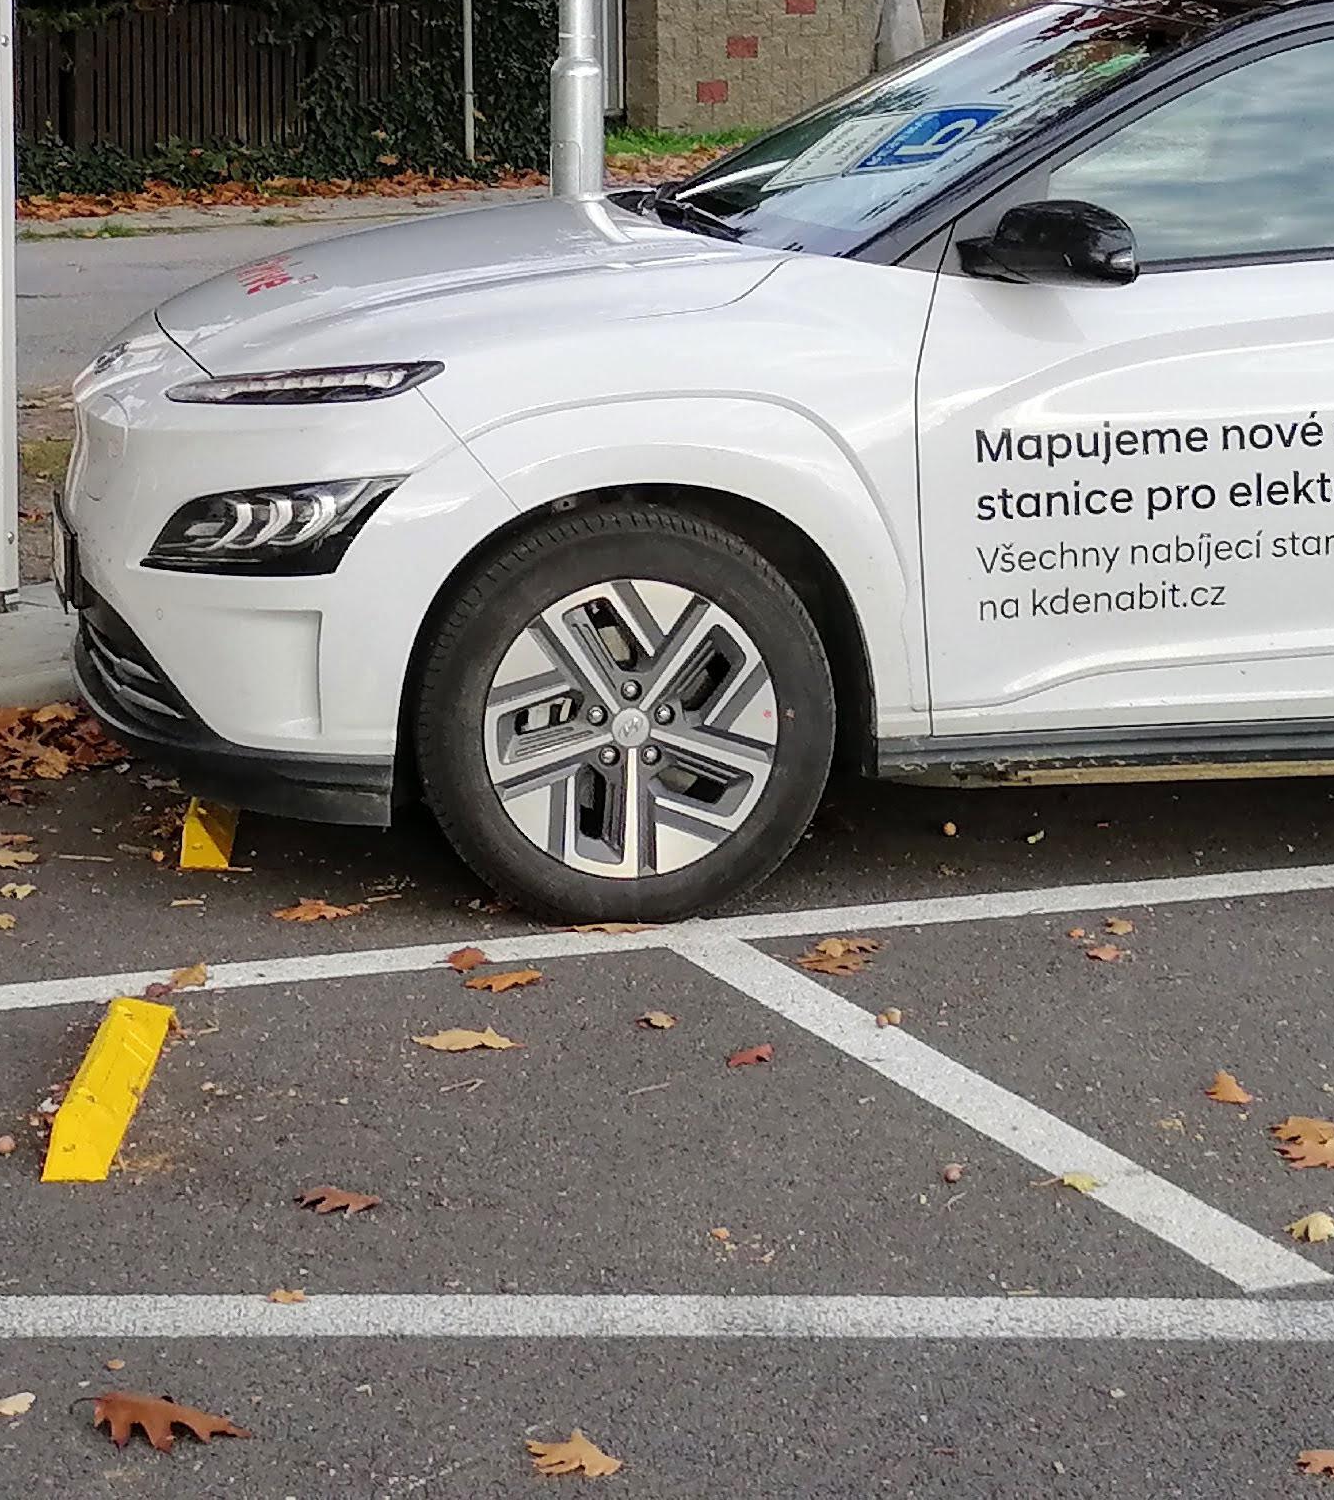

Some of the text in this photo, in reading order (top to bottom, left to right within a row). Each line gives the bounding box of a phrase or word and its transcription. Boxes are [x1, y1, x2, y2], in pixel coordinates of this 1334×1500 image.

[975, 420, 1209, 467] Mapujeme
[1221, 411, 1324, 451] nové
[976, 480, 1134, 521] stanice
[1147, 484, 1217, 520] pro
[976, 541, 1120, 574] Všechny
[1130, 529, 1264, 569] nabíjecí
[979, 580, 1227, 621] na kdenabit.cz
